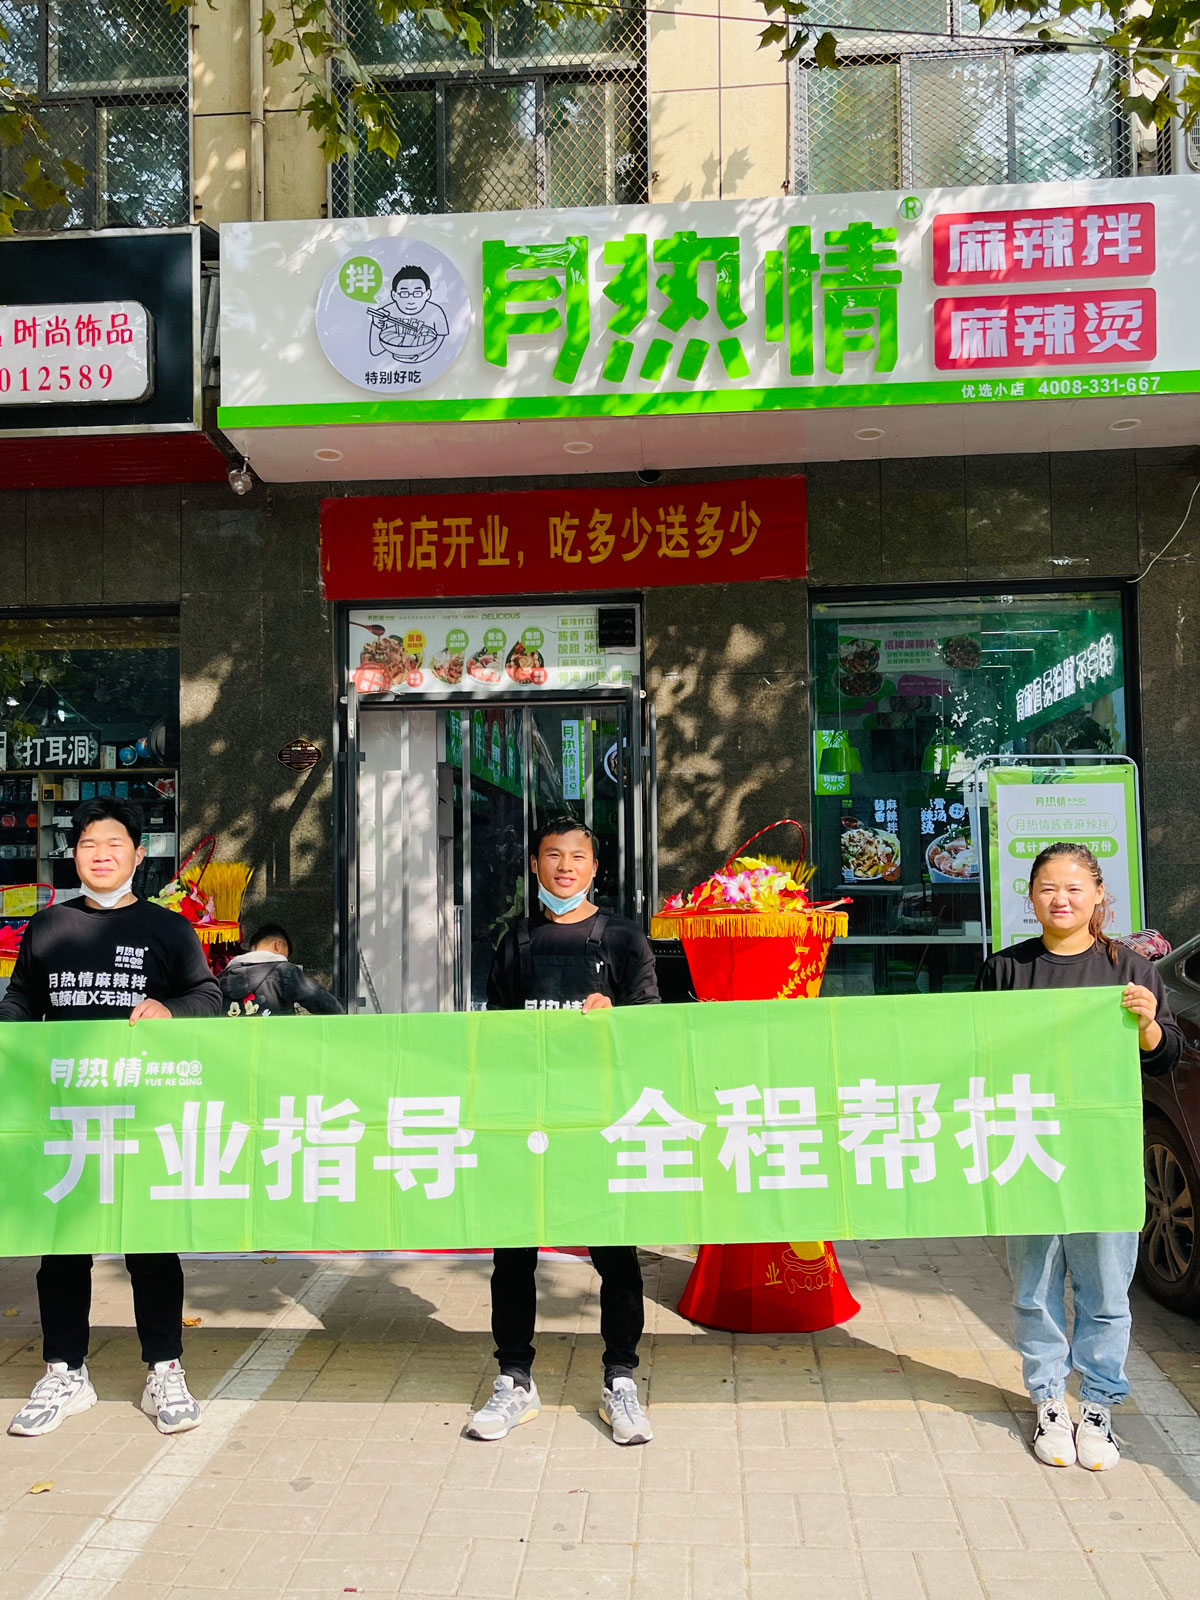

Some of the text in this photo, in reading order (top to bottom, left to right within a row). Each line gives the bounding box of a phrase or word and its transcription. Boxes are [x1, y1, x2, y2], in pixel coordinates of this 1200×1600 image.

[947, 212, 1143, 273] 麻辣拌
[345, 263, 377, 294] 拌
[482, 221, 902, 384] 月热情
[14, 313, 134, 349] 时尚饰品
[949, 300, 1144, 359] 麻辣烫
[0, 363, 113, 393] 012589
[364, 371, 422, 386] 特别好吃
[961, 376, 1161, 399] 优选小店 4008-331-667
[482, 612, 520, 620] DELICIOUS
[22, 736, 90, 766] 打耳洞
[48, 972, 147, 990] 月热情麻辣拌
[51, 1057, 142, 1088] 月热情
[144, 1077, 202, 1086] YUE RE QING
